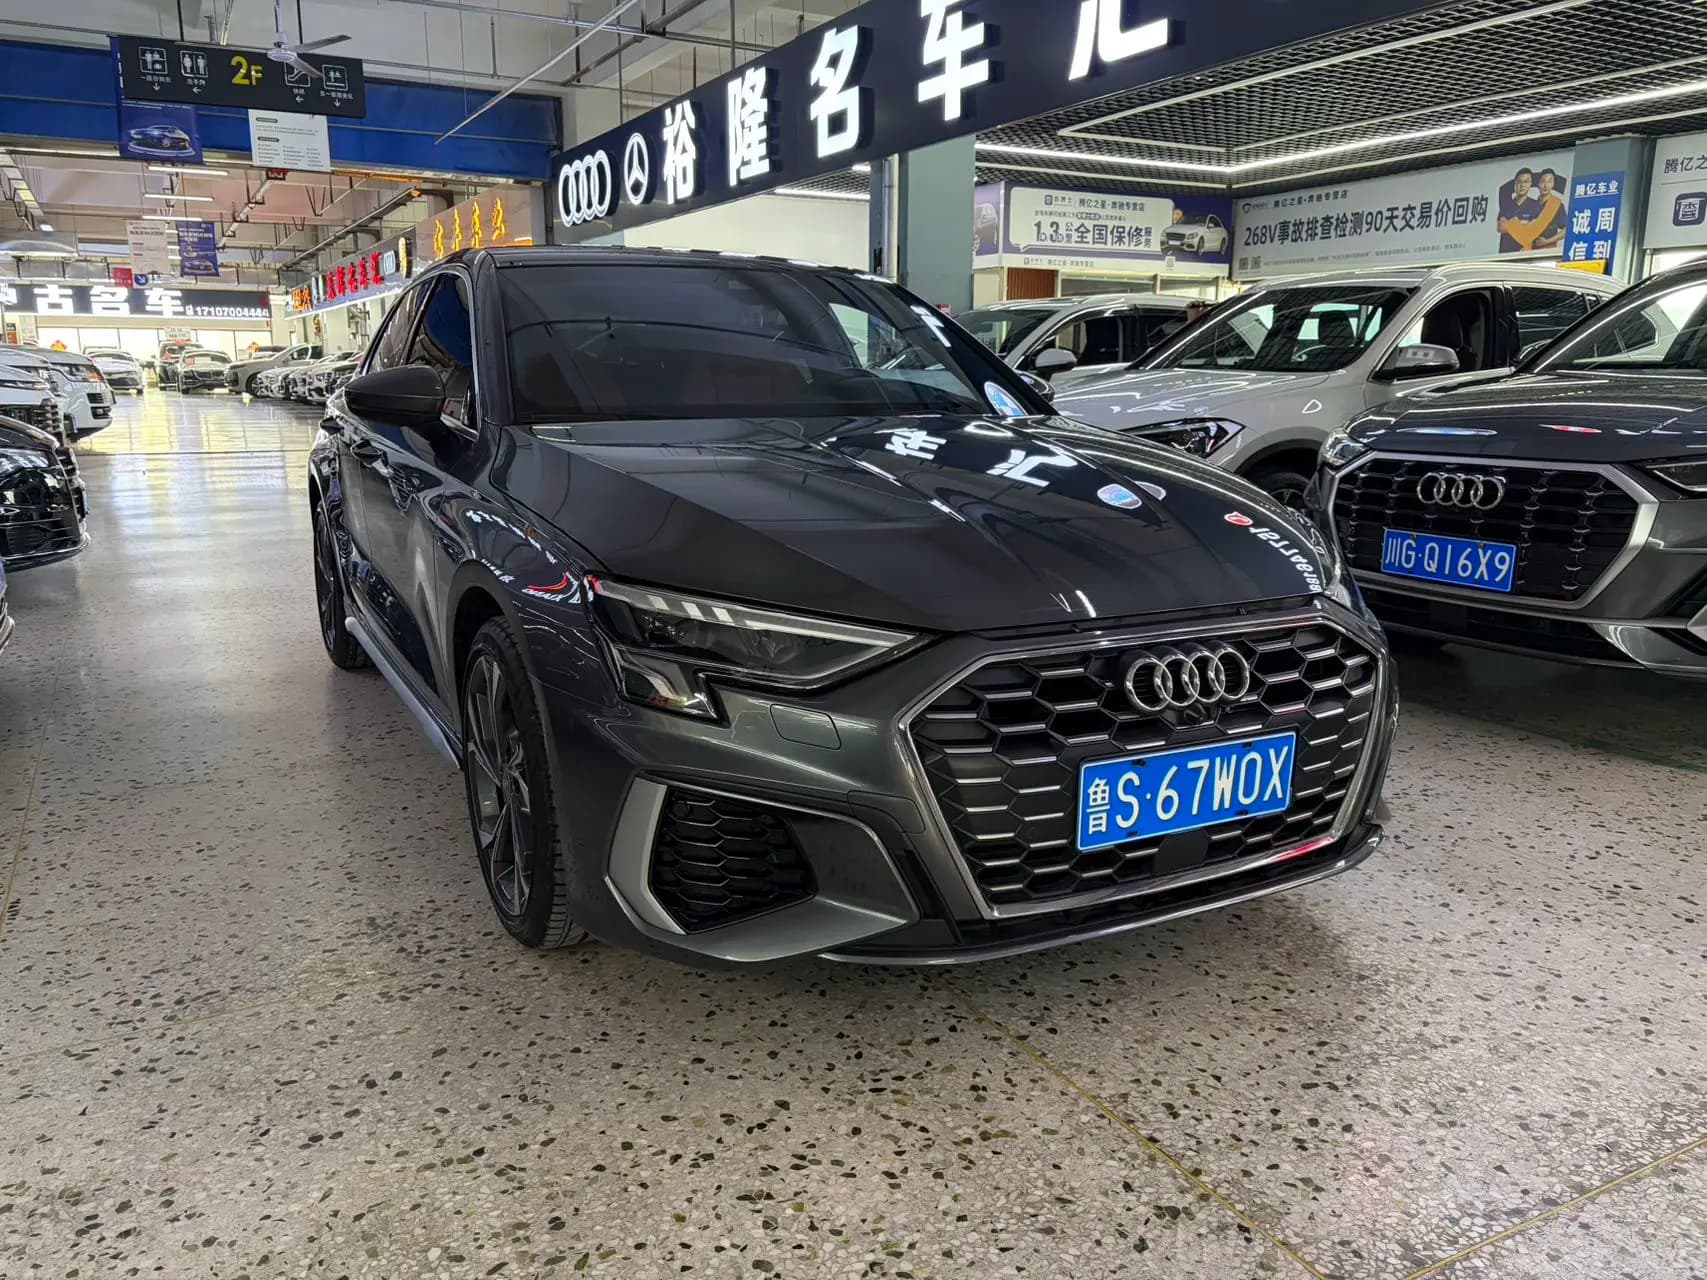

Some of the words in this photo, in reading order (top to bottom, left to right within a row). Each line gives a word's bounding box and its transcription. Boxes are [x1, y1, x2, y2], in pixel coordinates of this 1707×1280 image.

[231, 55, 264, 86] 2F
[1574, 180, 1619, 196] 腾亿车业
[1244, 194, 1489, 247] 268V事故排查检测90天交易价回购
[1385, 537, 1510, 582] 川G·Q16X9
